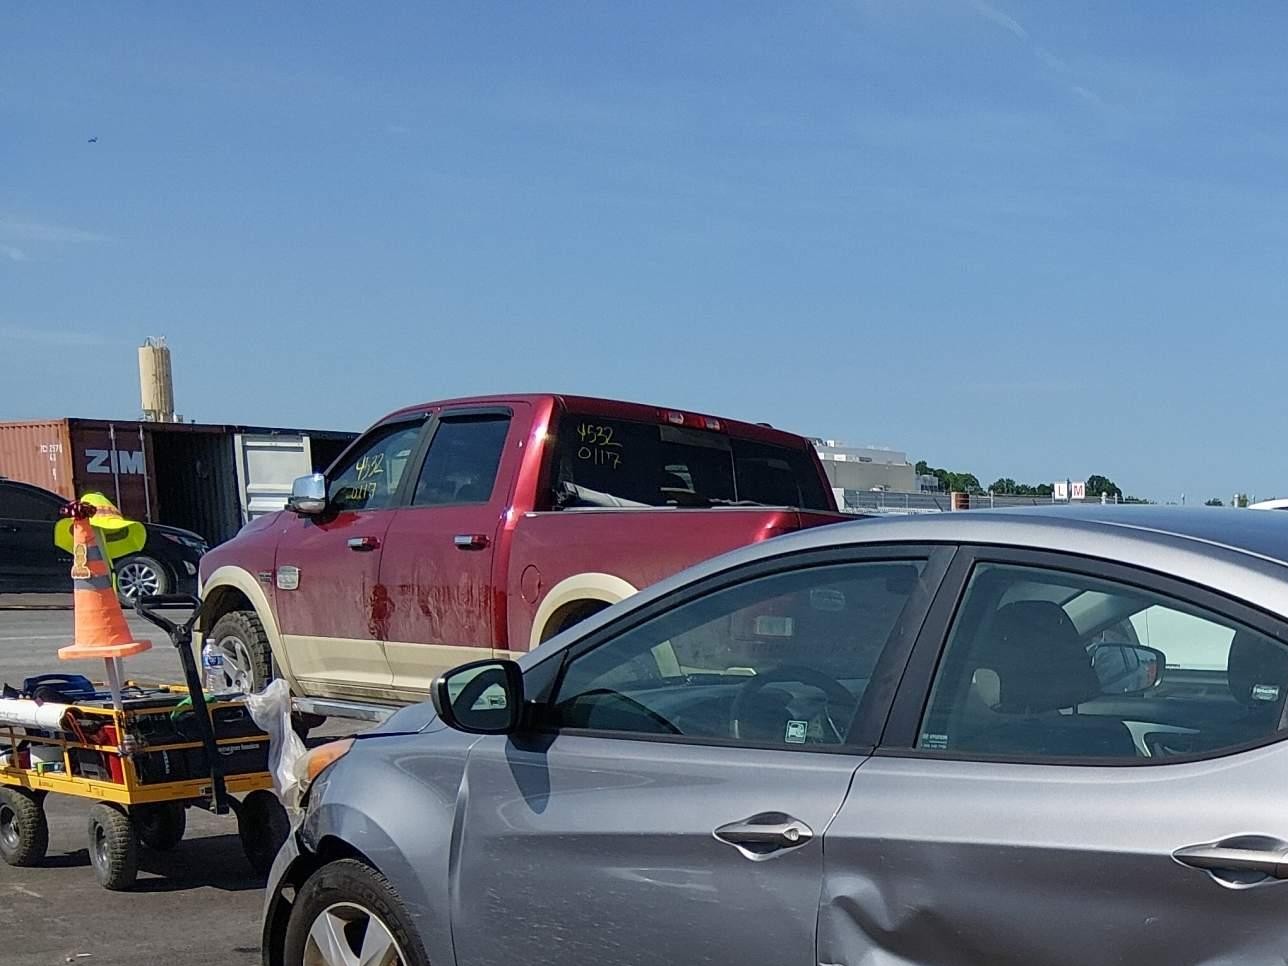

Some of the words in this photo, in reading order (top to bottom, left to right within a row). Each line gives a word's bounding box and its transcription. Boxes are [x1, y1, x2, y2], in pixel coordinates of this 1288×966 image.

[577, 422, 623, 447] 4532
[85, 449, 145, 475] ZIM
[578, 446, 623, 469] 0117
[1073, 485, 1084, 497] M
